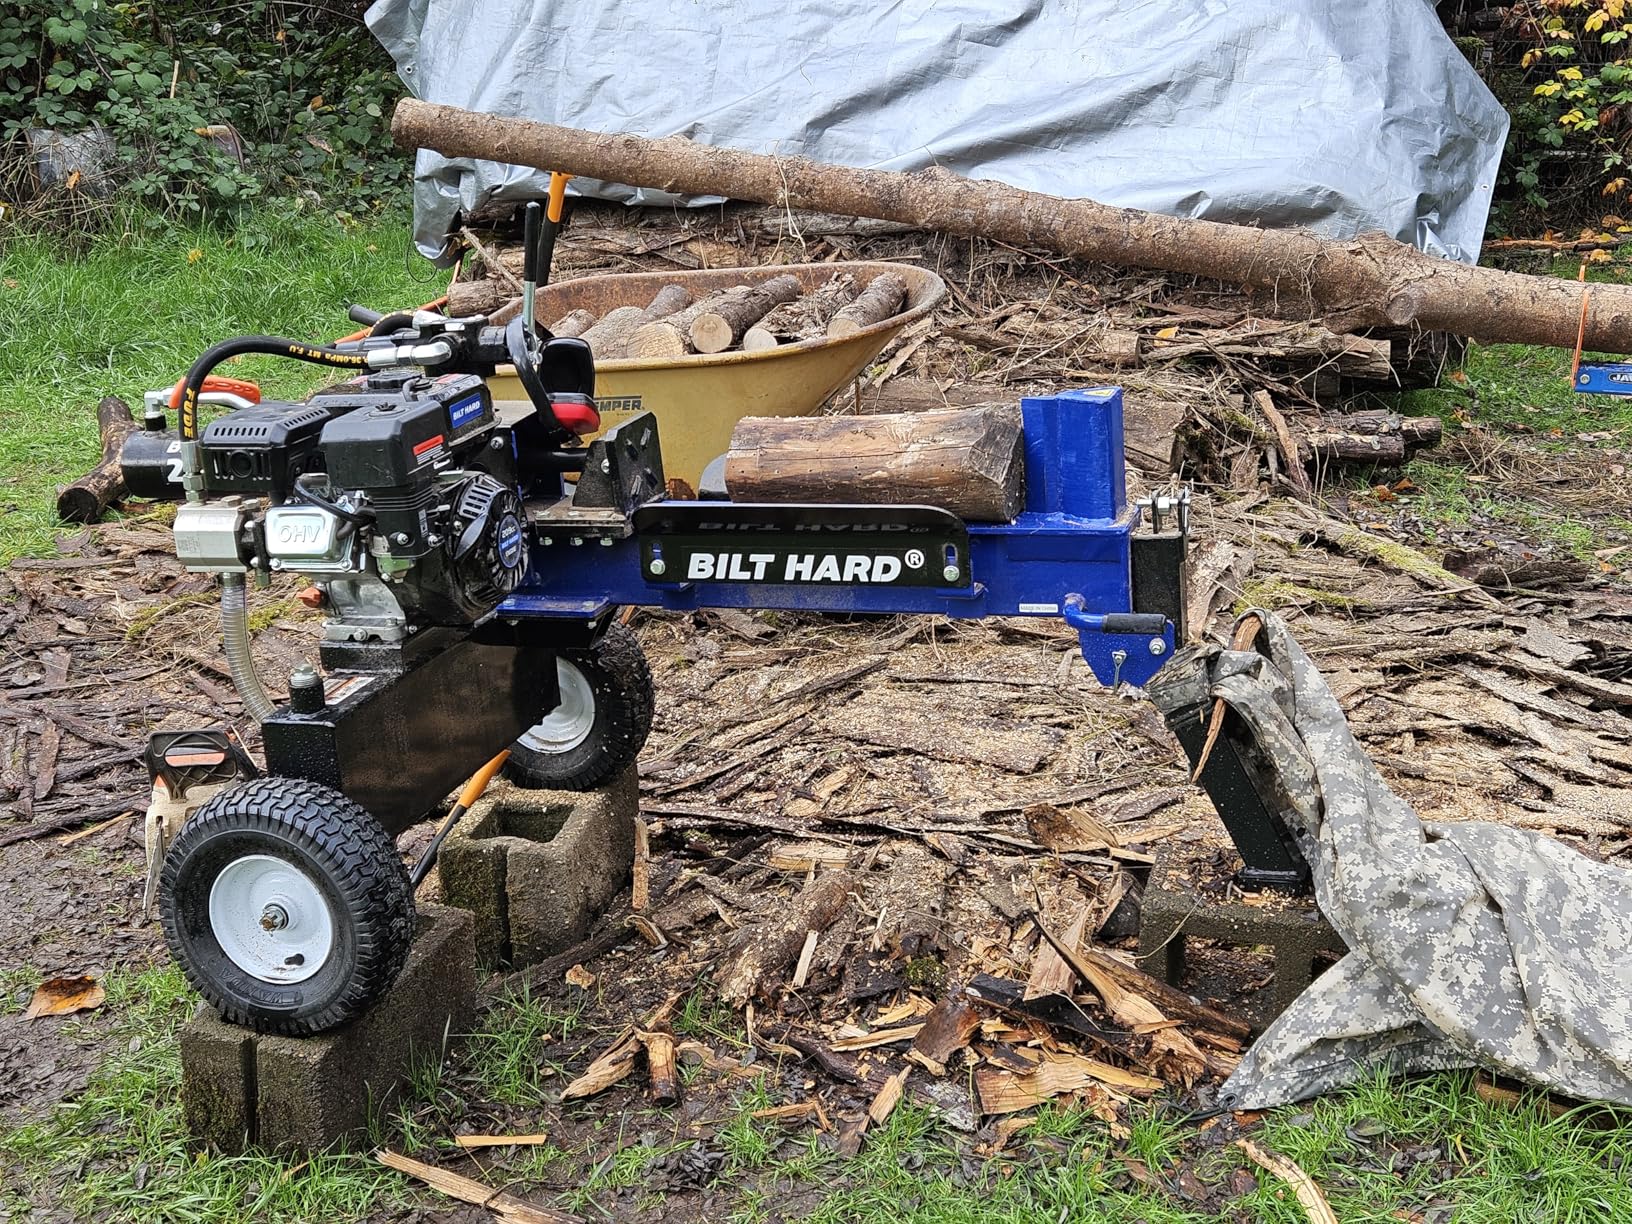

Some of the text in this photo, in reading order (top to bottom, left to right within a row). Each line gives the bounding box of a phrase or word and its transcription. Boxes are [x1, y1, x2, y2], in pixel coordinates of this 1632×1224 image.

[183, 388, 195, 438] FUDE
[453, 400, 481, 421] BILT HARD
[280, 525, 321, 543] OHV
[688, 553, 775, 580] BILT
